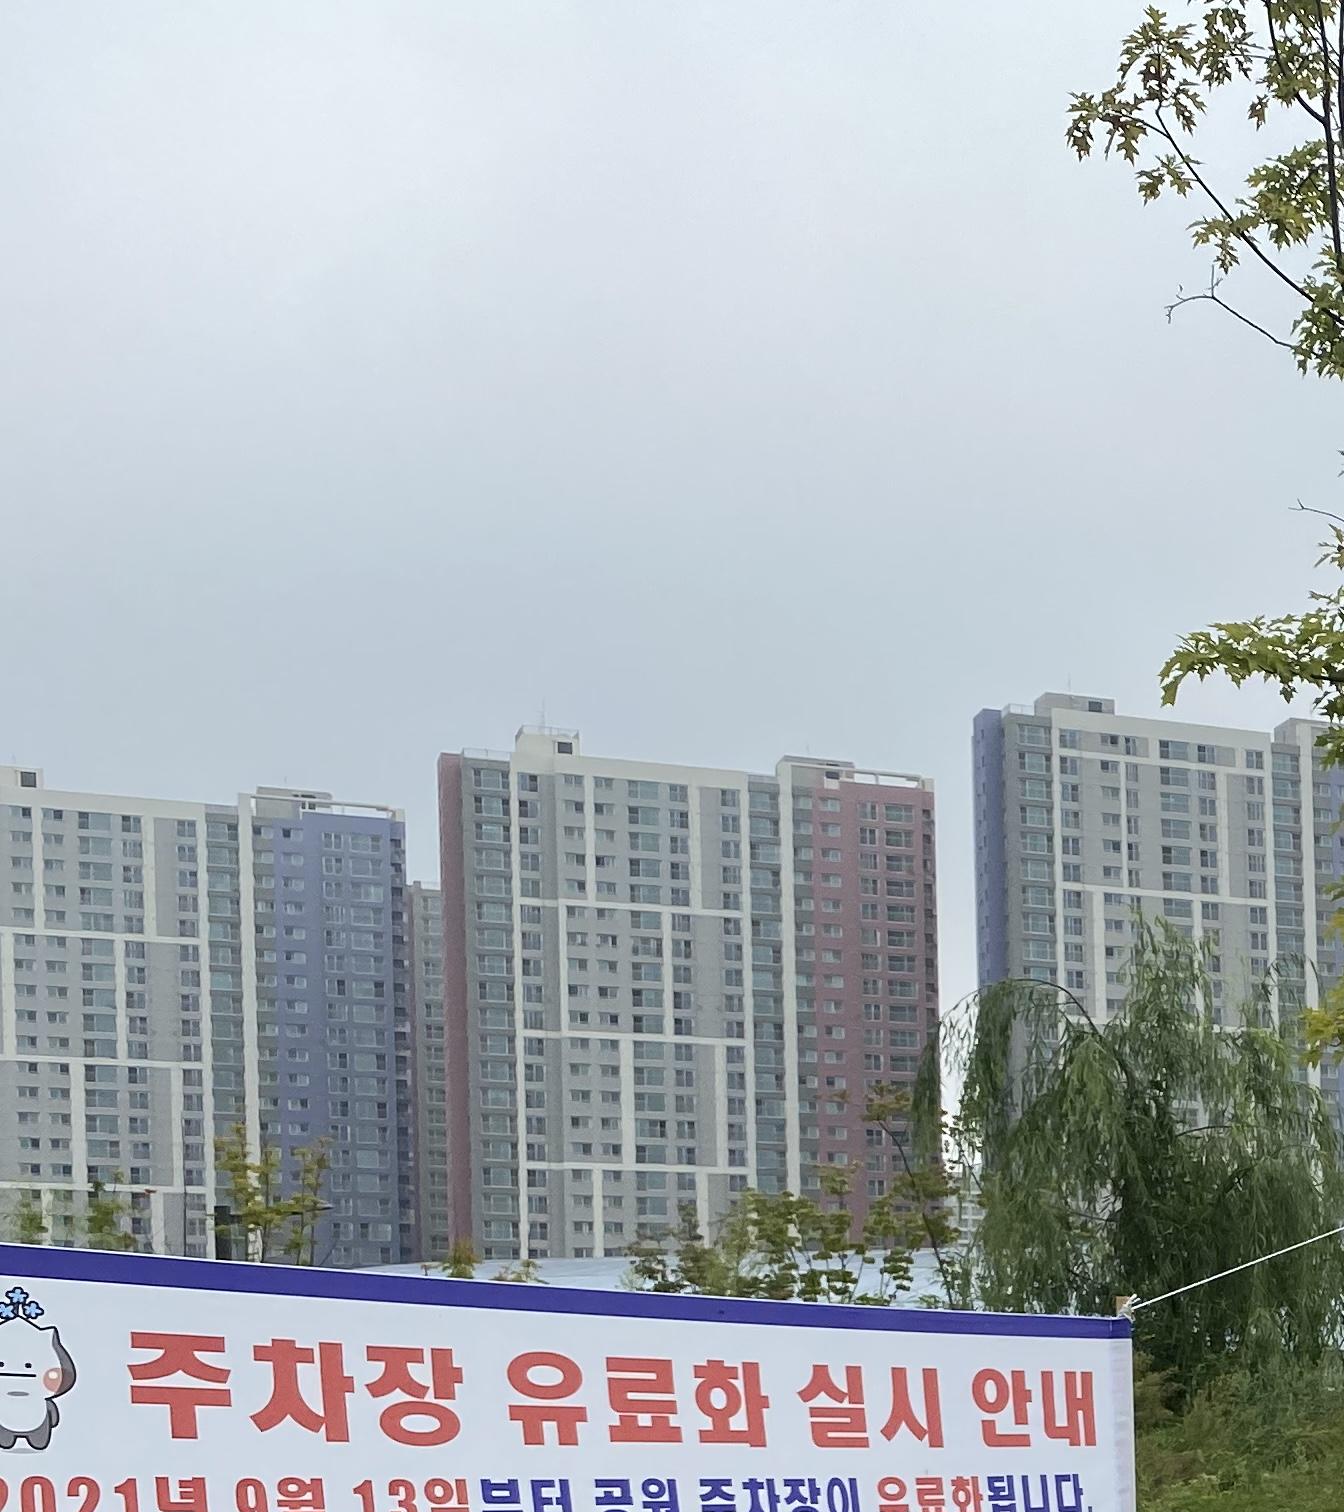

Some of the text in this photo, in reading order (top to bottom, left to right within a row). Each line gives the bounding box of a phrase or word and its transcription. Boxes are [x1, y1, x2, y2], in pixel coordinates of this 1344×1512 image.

[127, 1332, 1096, 1448] 주차장 유료화 실시 안내
